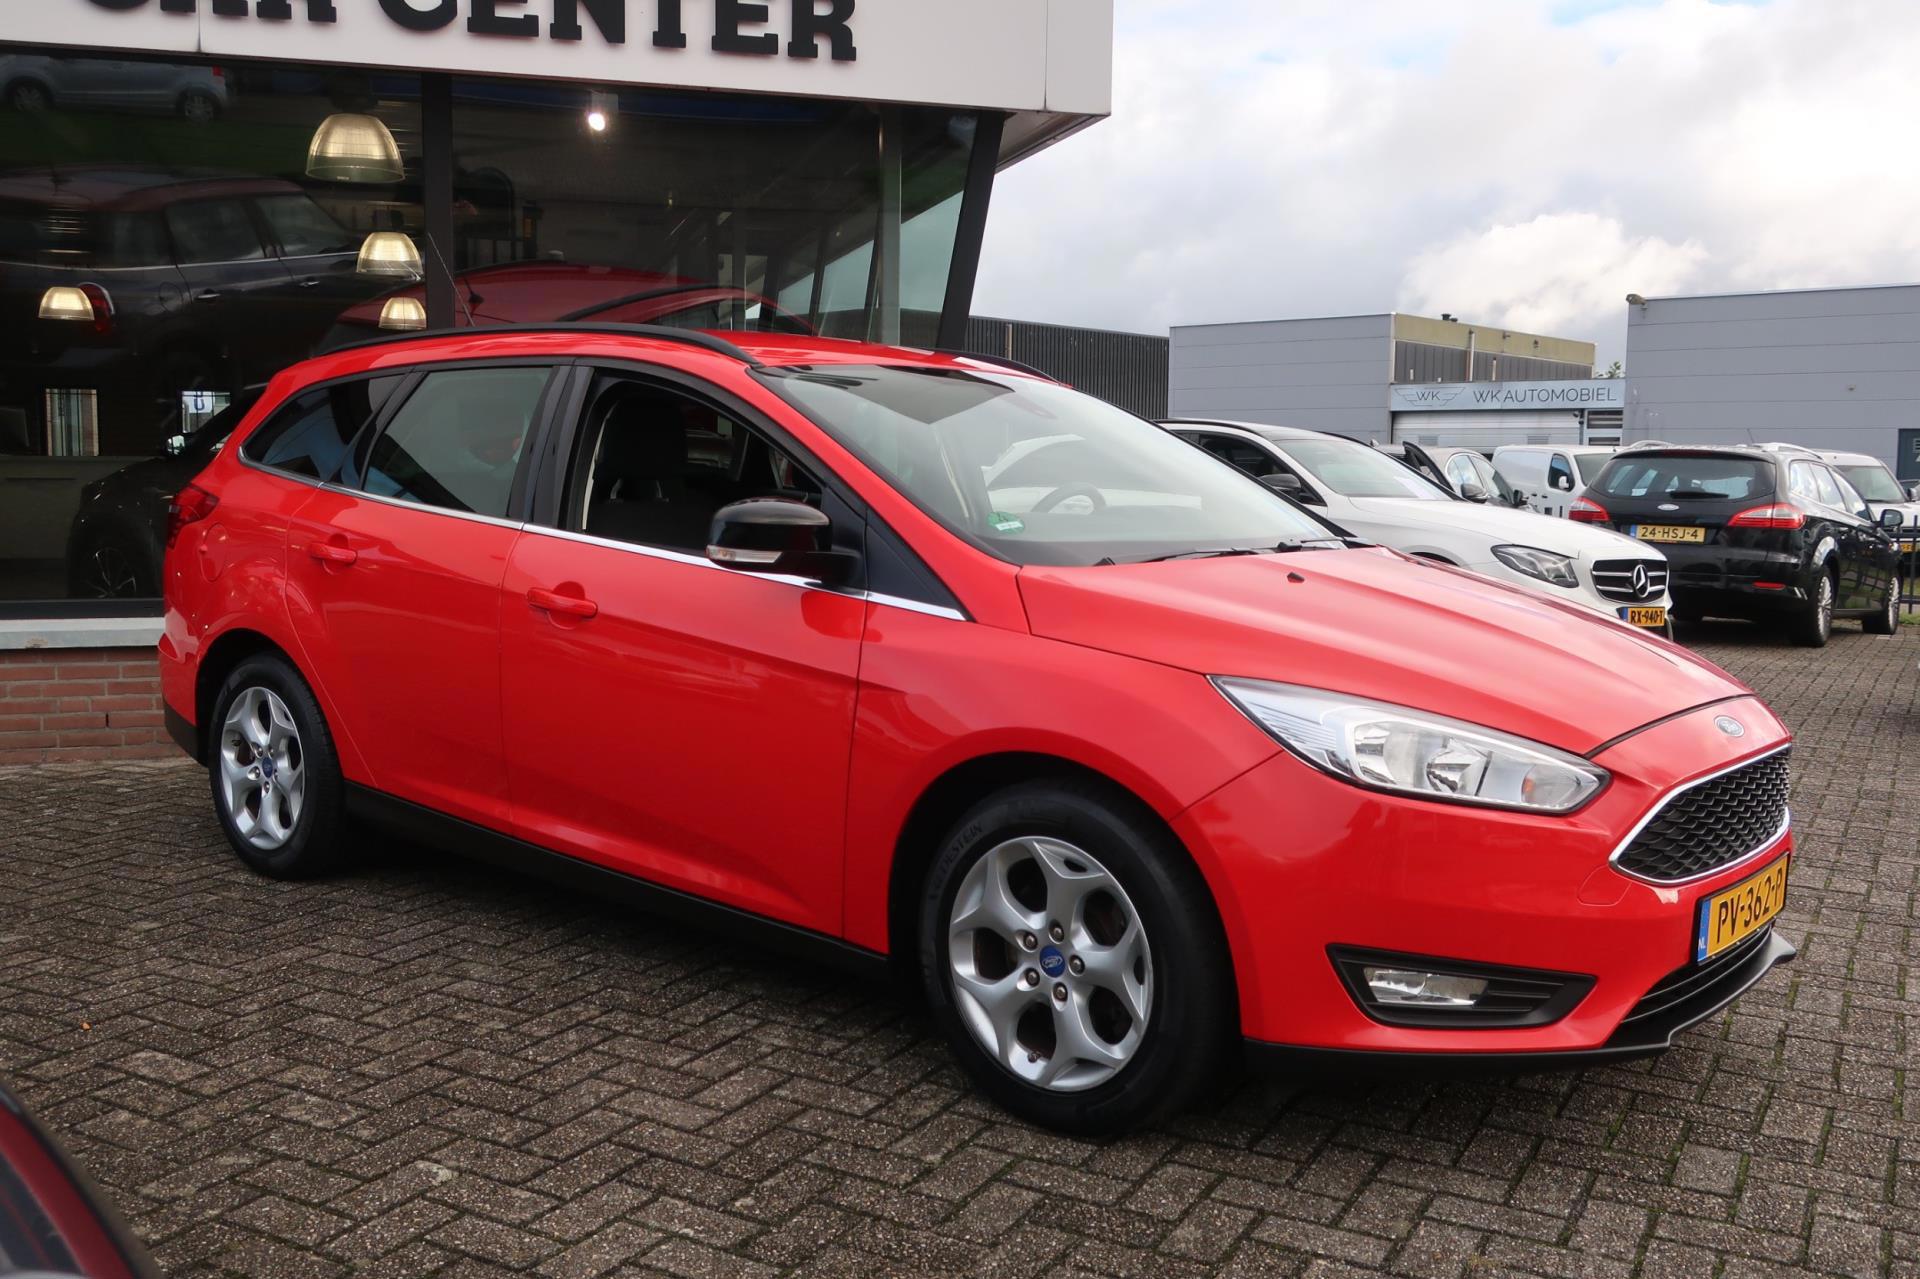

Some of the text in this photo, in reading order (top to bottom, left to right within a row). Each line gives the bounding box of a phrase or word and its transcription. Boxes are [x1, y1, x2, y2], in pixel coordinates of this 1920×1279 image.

[1416, 391, 1440, 401] WK
[1473, 387, 1617, 403] WK AUTOMOBIEL
[1641, 526, 1698, 540] 24-HSJ-4
[1716, 867, 1783, 944] PV-362-P
